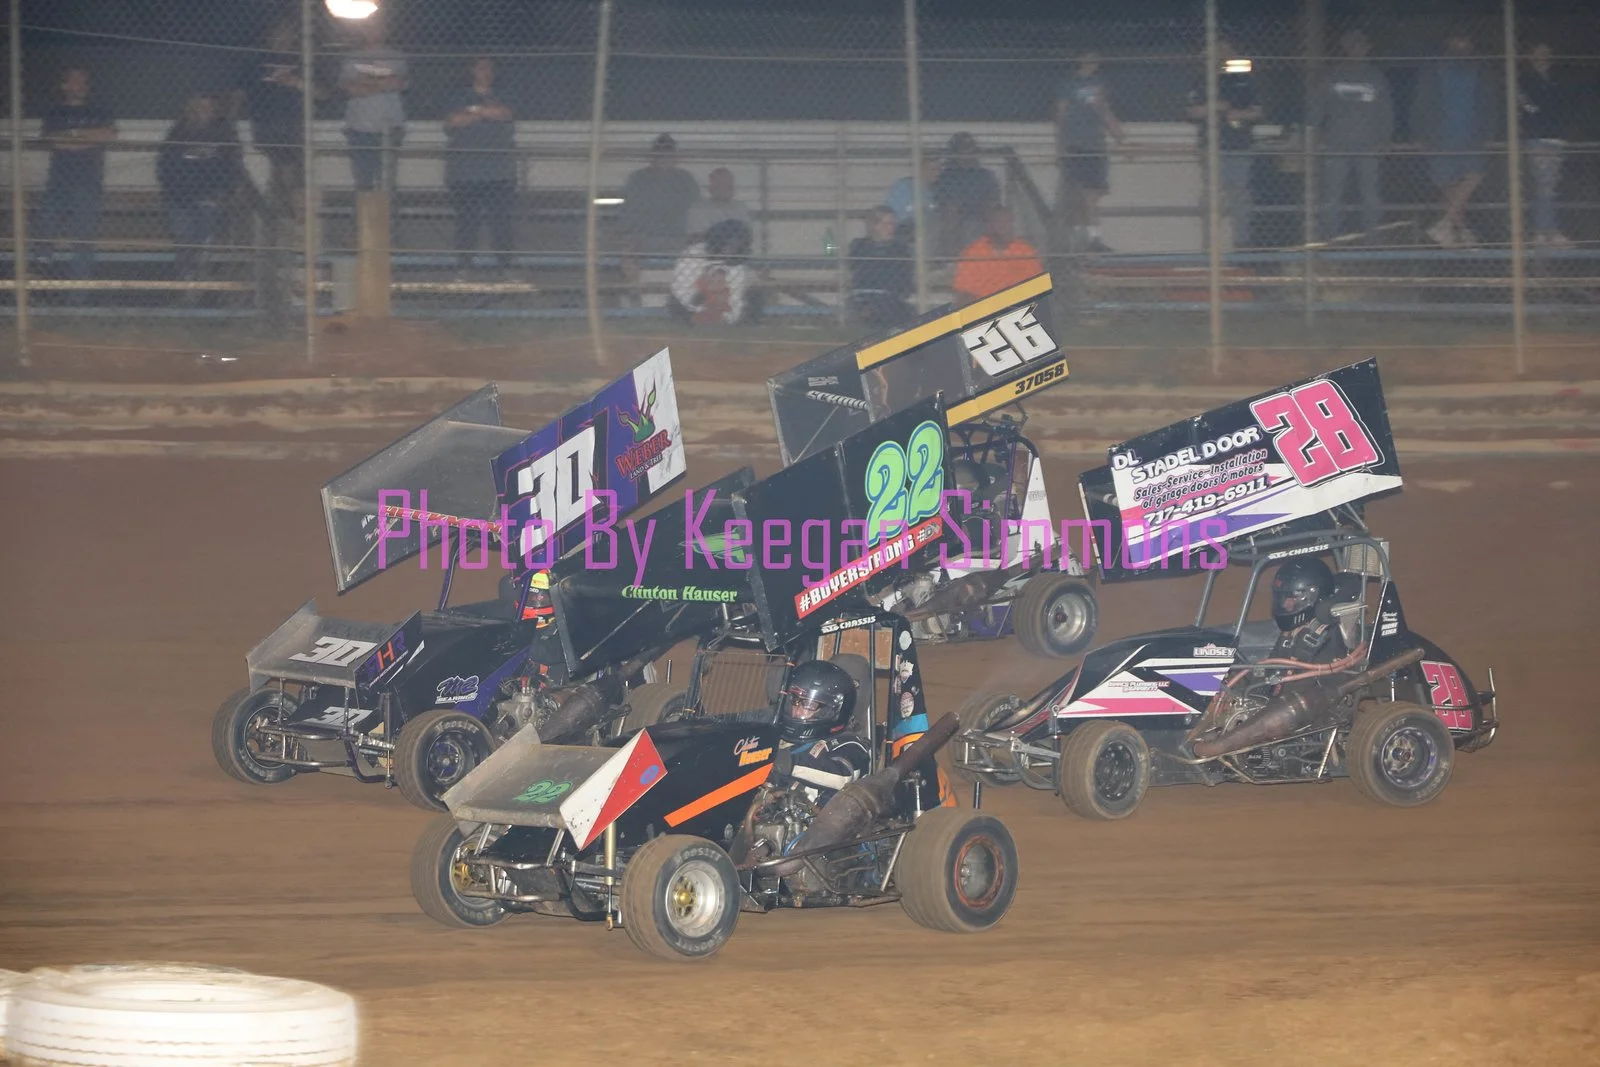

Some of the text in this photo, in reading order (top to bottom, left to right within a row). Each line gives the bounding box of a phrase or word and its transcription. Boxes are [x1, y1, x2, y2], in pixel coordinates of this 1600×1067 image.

[960, 303, 1058, 377] 26
[1015, 362, 1065, 395] 37058
[616, 429, 672, 478] WEBER
[1131, 426, 1262, 483] STADEL DOOR
[1250, 379, 1385, 488] 28
[1113, 449, 1141, 470] DL
[518, 426, 602, 557] 30
[865, 420, 944, 547] 22
[1142, 462, 1264, 509] of garage doors & motors
[1143, 475, 1271, 526] 717-419-6911
[799, 534, 915, 612] #BOYERSTRONG
[1288, 544, 1329, 556] CHASSIS
[622, 585, 738, 602] Clinton Hauser
[840, 616, 877, 629] CHASSIS
[288, 636, 378, 667] 30
[1193, 646, 1236, 657] LINDSEY
[303, 706, 374, 728] 30
[1420, 660, 1473, 733] 28
[512, 780, 573, 804] 22
